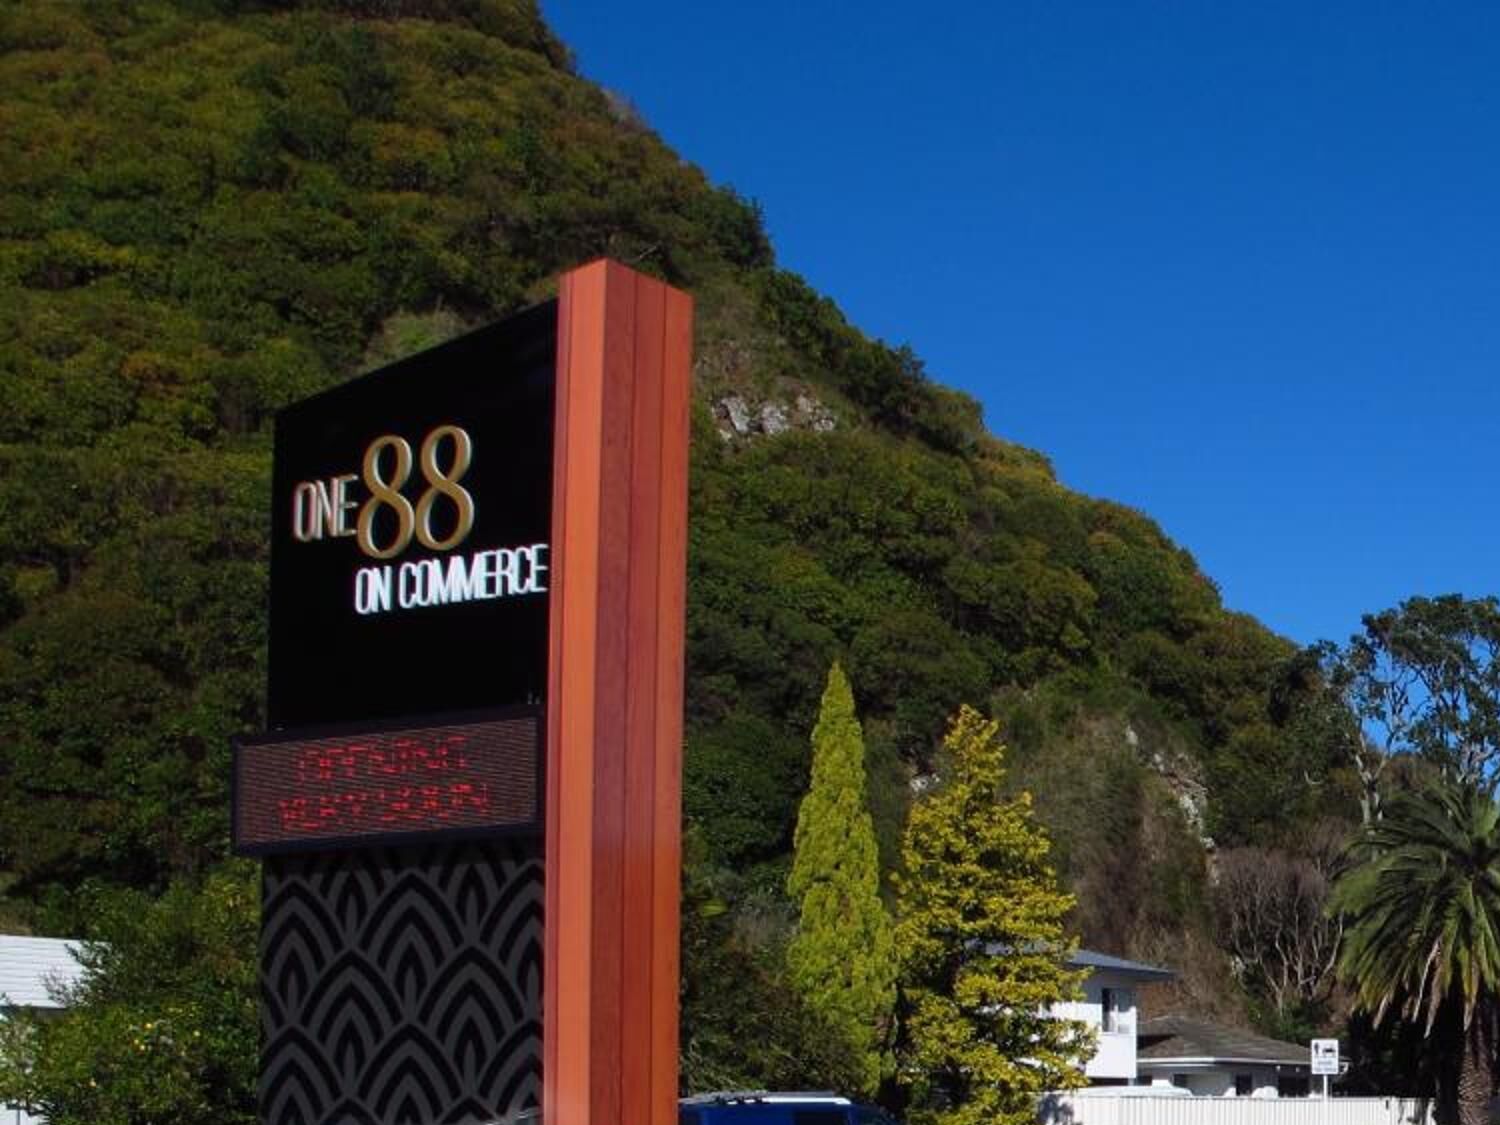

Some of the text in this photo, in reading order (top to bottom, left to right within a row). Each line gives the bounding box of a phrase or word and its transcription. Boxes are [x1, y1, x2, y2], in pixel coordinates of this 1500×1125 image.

[292, 424, 476, 559] ONE 88
[354, 543, 549, 615] ON COMMERCE
